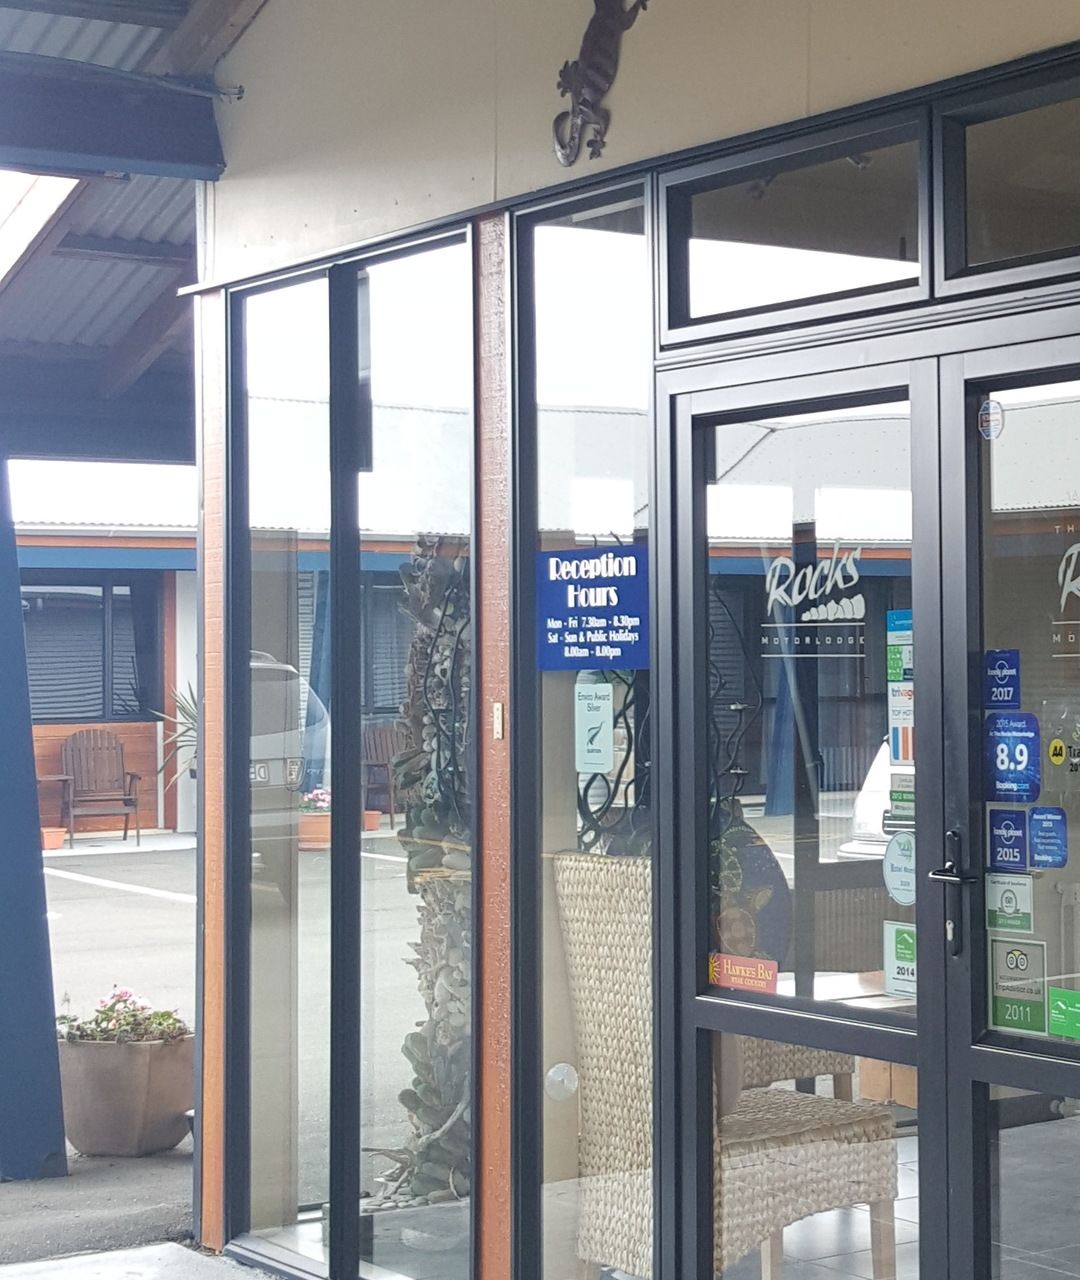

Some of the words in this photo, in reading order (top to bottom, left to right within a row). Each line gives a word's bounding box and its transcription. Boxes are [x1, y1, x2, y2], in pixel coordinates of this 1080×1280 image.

[548, 552, 637, 581] Reception
[765, 539, 862, 616] Rocks
[567, 584, 619, 608] Hours
[547, 618, 562, 629] Mon
[568, 616, 578, 628] Fri
[581, 616, 607, 628] 7.30am
[613, 615, 640, 629] 8.30pm
[547, 632, 558, 643] Sat
[564, 631, 577, 643] Sun
[579, 632, 585, 642] &
[586, 630, 608, 642] Public
[609, 629, 640, 645] Holidays
[761, 636, 865, 645] MOTORLODGE
[564, 646, 589, 657] 8.00am
[595, 645, 621, 660] 8.00pm
[594, 691, 611, 701] Award
[891, 686, 913, 700] trivag
[991, 687, 1014, 700] 2017
[996, 743, 1029, 770] 8.9
[1052, 745, 1063, 758] AA
[996, 847, 1020, 862] 2015
[758, 963, 774, 981] BAY
[896, 965, 915, 977] 2014
[1005, 1003, 1031, 1023] 2011
